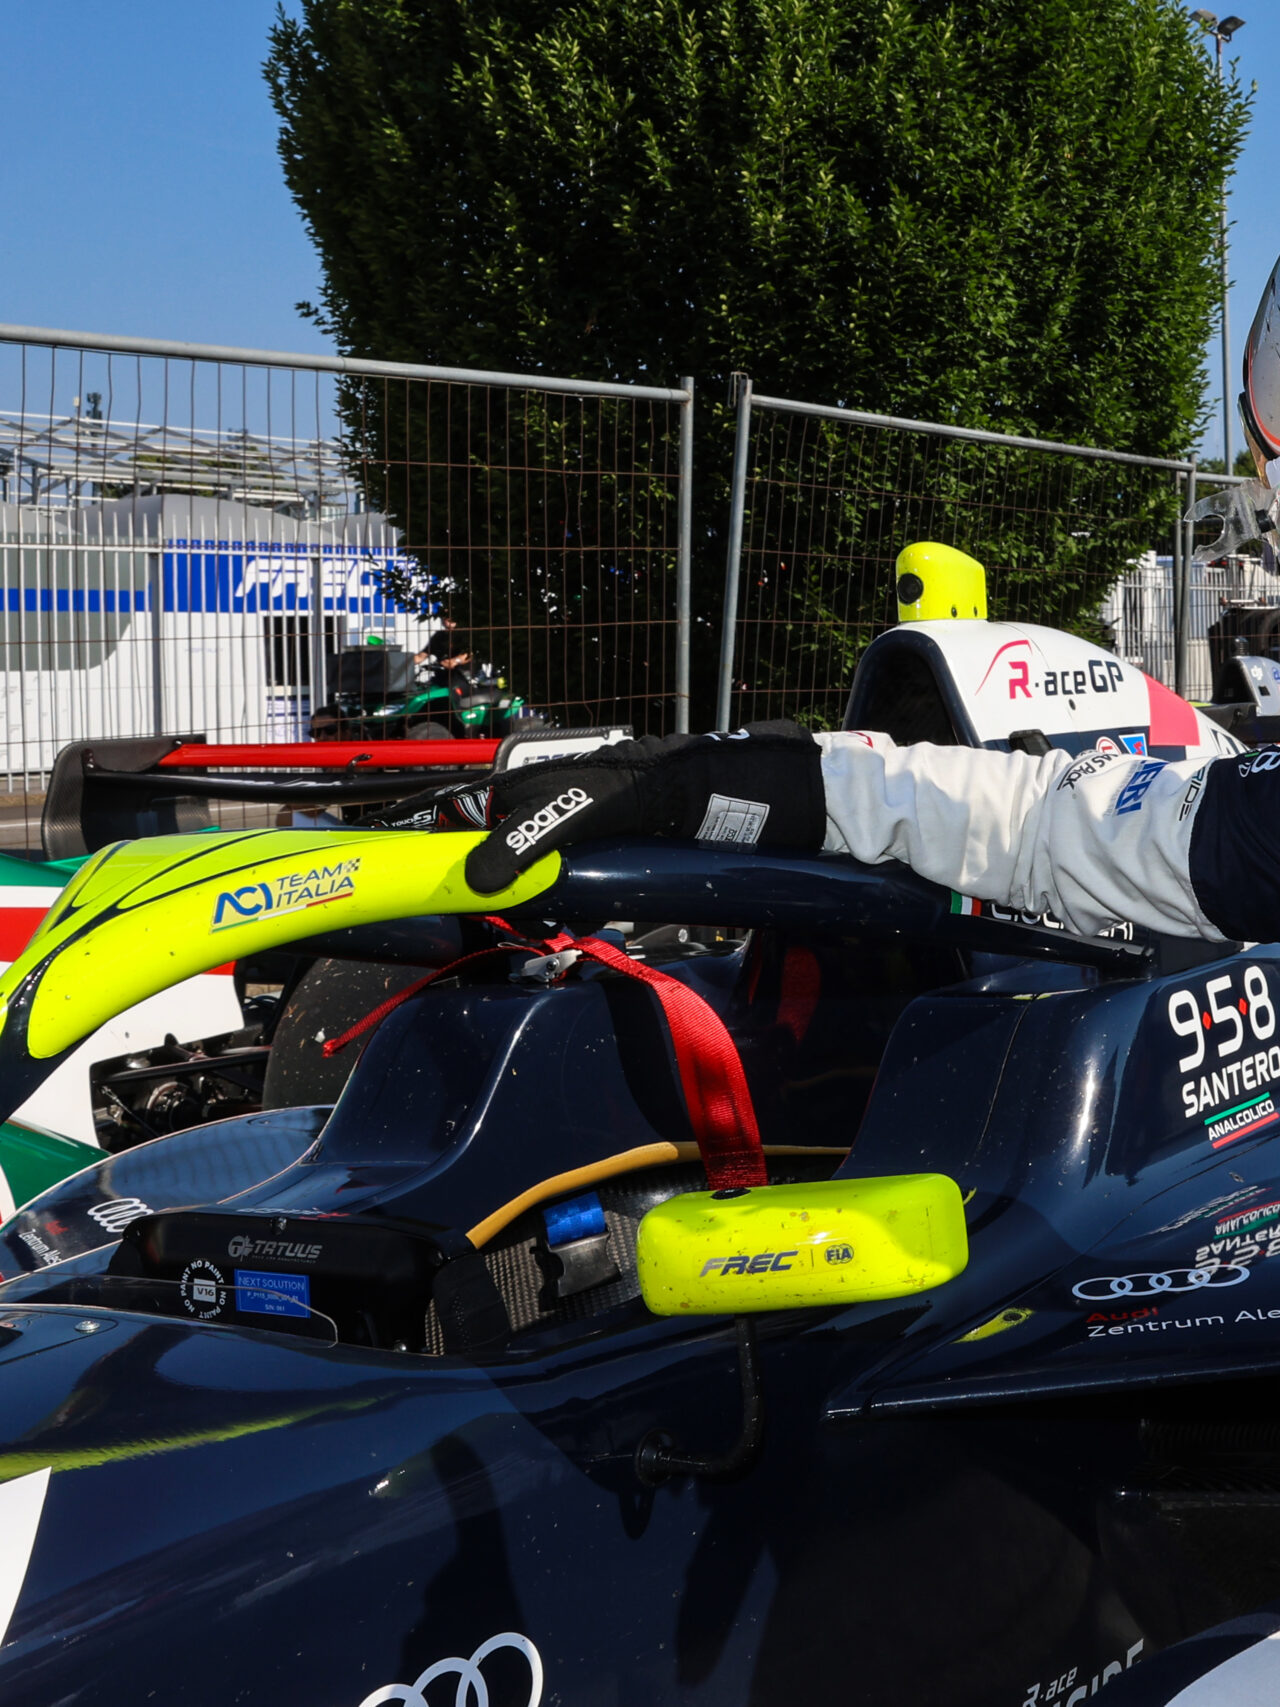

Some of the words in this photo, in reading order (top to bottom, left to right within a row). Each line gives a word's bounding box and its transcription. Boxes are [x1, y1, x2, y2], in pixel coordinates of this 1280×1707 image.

[506, 787, 594, 855] sparco
[276, 862, 343, 891] TEAM
[213, 882, 274, 924] ACI
[276, 876, 354, 908] ITALIA
[1208, 1099, 1276, 1142] ANALCOLICO
[253, 1239, 323, 1259] TATUUS
[698, 1250, 799, 1278] FREC
[196, 1286, 215, 1298] V16
[238, 1276, 261, 1287] NEXT
[262, 1277, 305, 1291] SOLUTION
[1085, 1305, 1159, 1323] Audi
[1087, 1312, 1225, 1338] Zentrum
